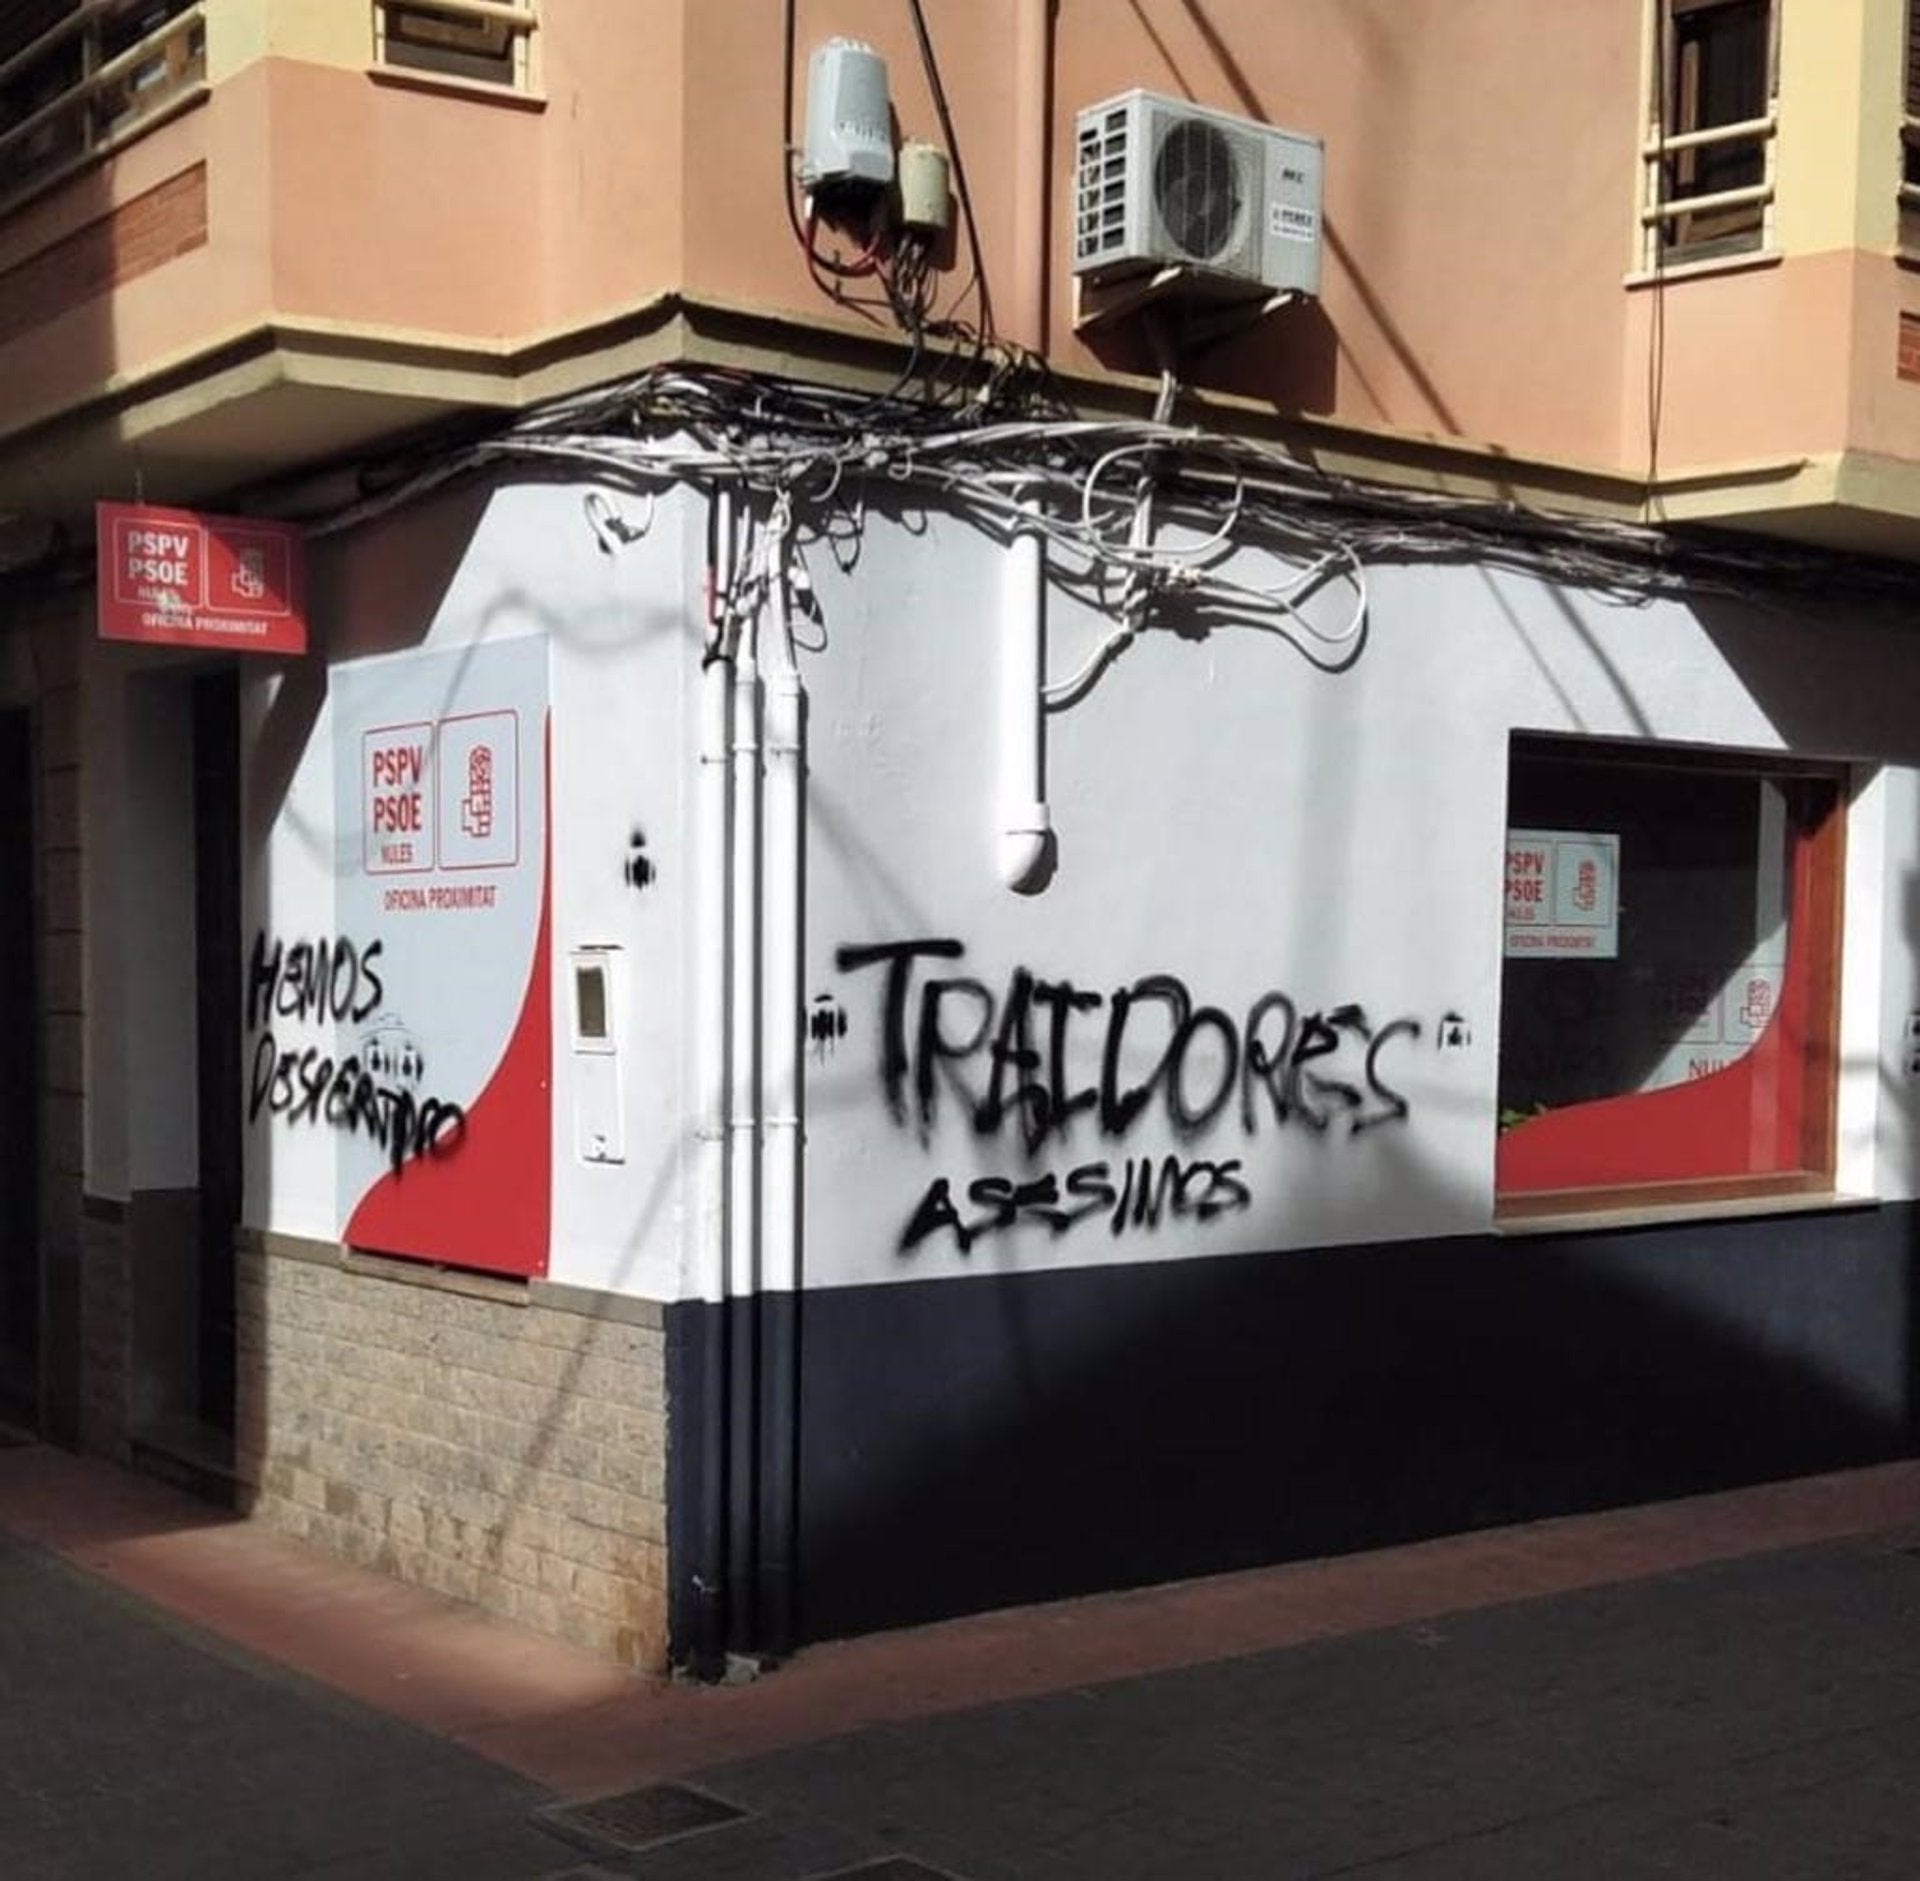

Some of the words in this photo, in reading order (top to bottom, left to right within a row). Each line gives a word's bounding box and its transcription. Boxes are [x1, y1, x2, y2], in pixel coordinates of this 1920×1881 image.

[128, 530, 189, 557] PSPV
[128, 557, 189, 586] PSOE
[373, 745, 422, 787] PSPV
[374, 793, 422, 833] PSOE
[384, 888, 426, 911] OFICINA
[248, 931, 383, 1031] HEMOS
[834, 938, 1421, 1157] TRAIDORES
[898, 1153, 1252, 1256] ASESINOS
